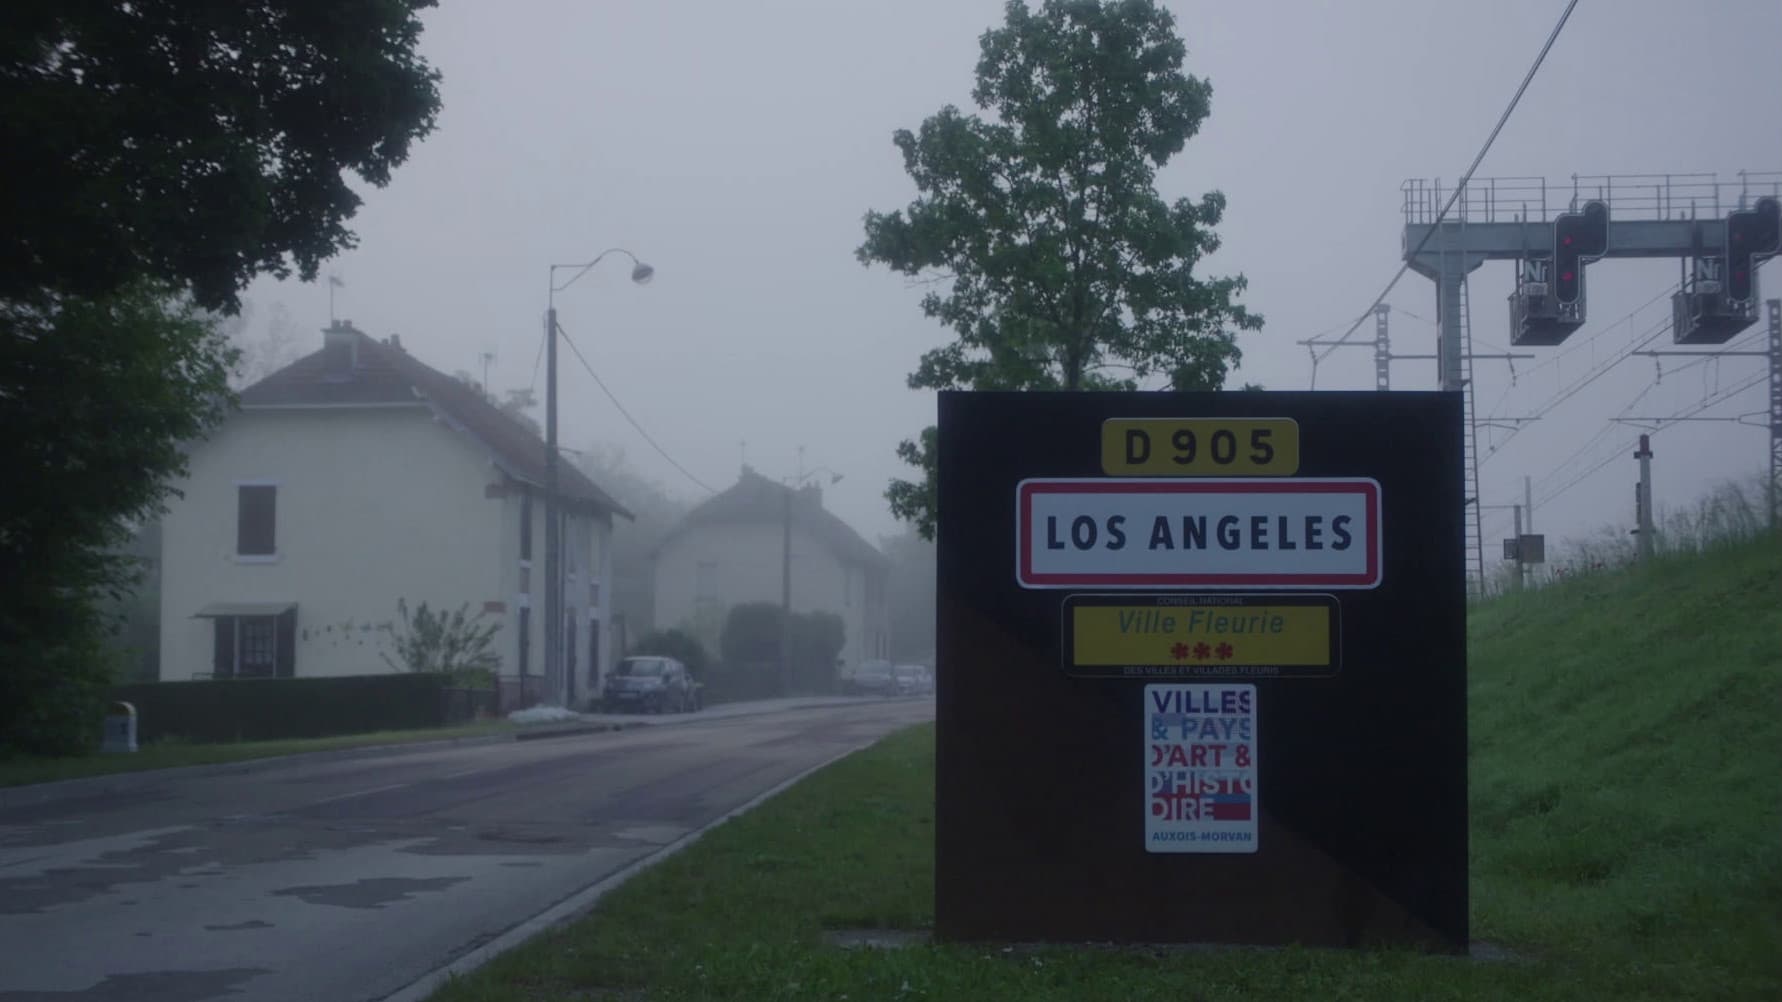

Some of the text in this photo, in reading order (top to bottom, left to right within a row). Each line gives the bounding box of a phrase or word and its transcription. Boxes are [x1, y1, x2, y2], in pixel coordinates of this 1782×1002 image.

[1125, 429, 1274, 465] D 905
[1047, 515, 1353, 550] LOS ANGELES
[1118, 609, 1285, 634] Ville Fleurie
[1152, 690, 1250, 713] VILLES
[1182, 716, 1250, 740] PAYS
[1235, 743, 1251, 767] &
[1152, 831, 1252, 841] AUXOIS-MORVAN
